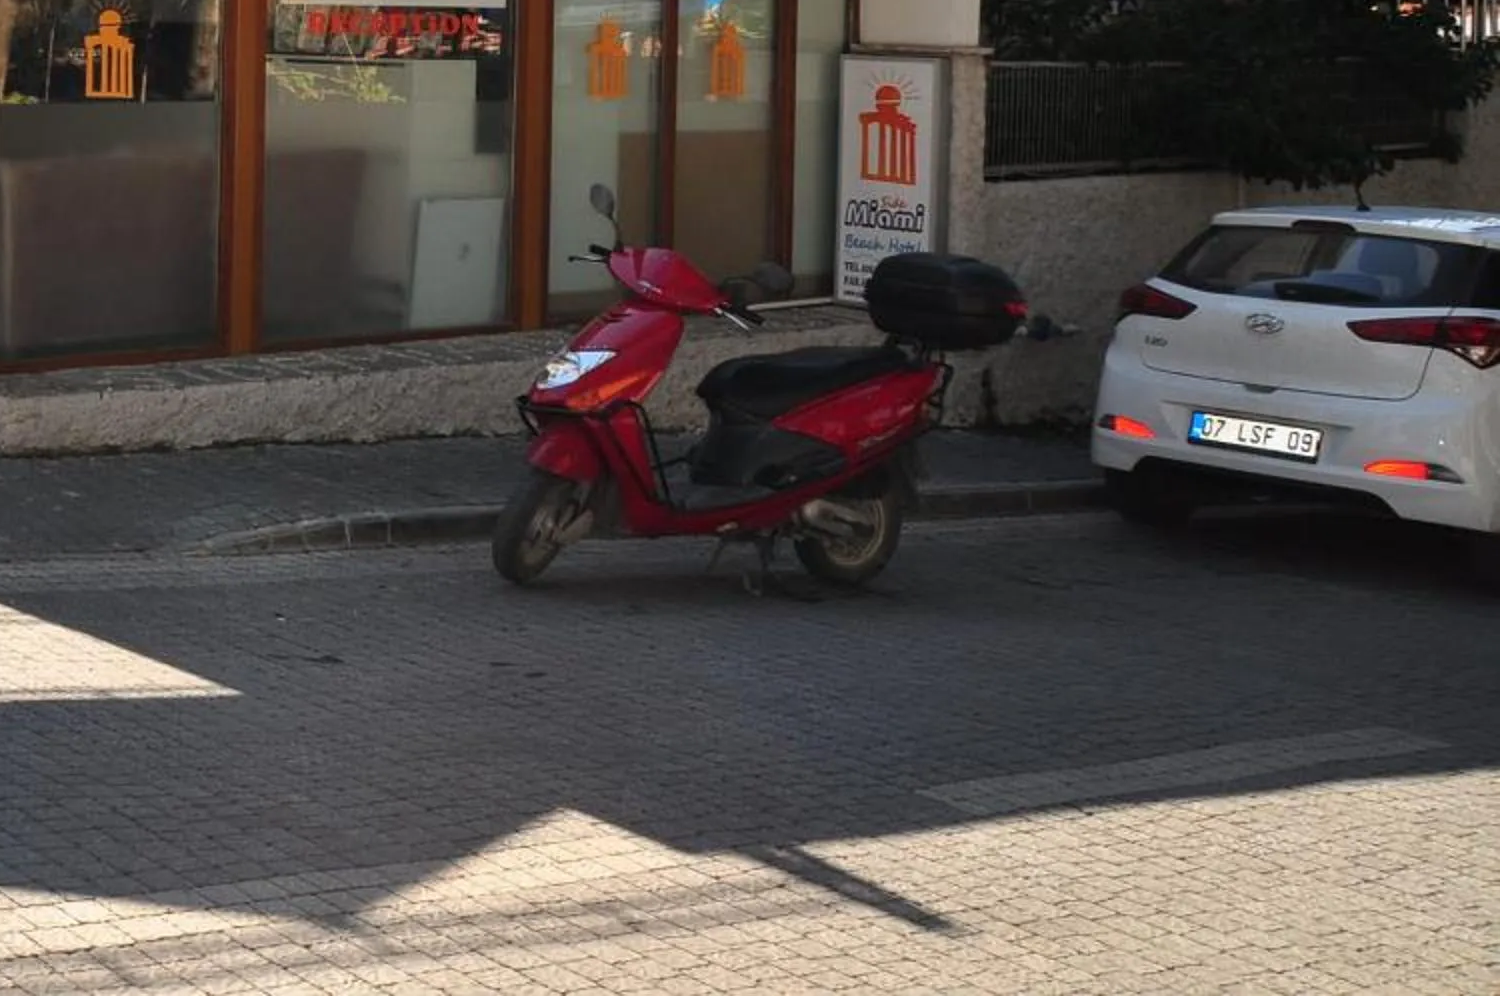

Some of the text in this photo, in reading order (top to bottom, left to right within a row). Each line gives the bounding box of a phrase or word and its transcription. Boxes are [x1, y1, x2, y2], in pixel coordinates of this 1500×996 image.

[844, 199, 925, 232] Miami
[1202, 417, 1313, 453] 07 LSF 09
